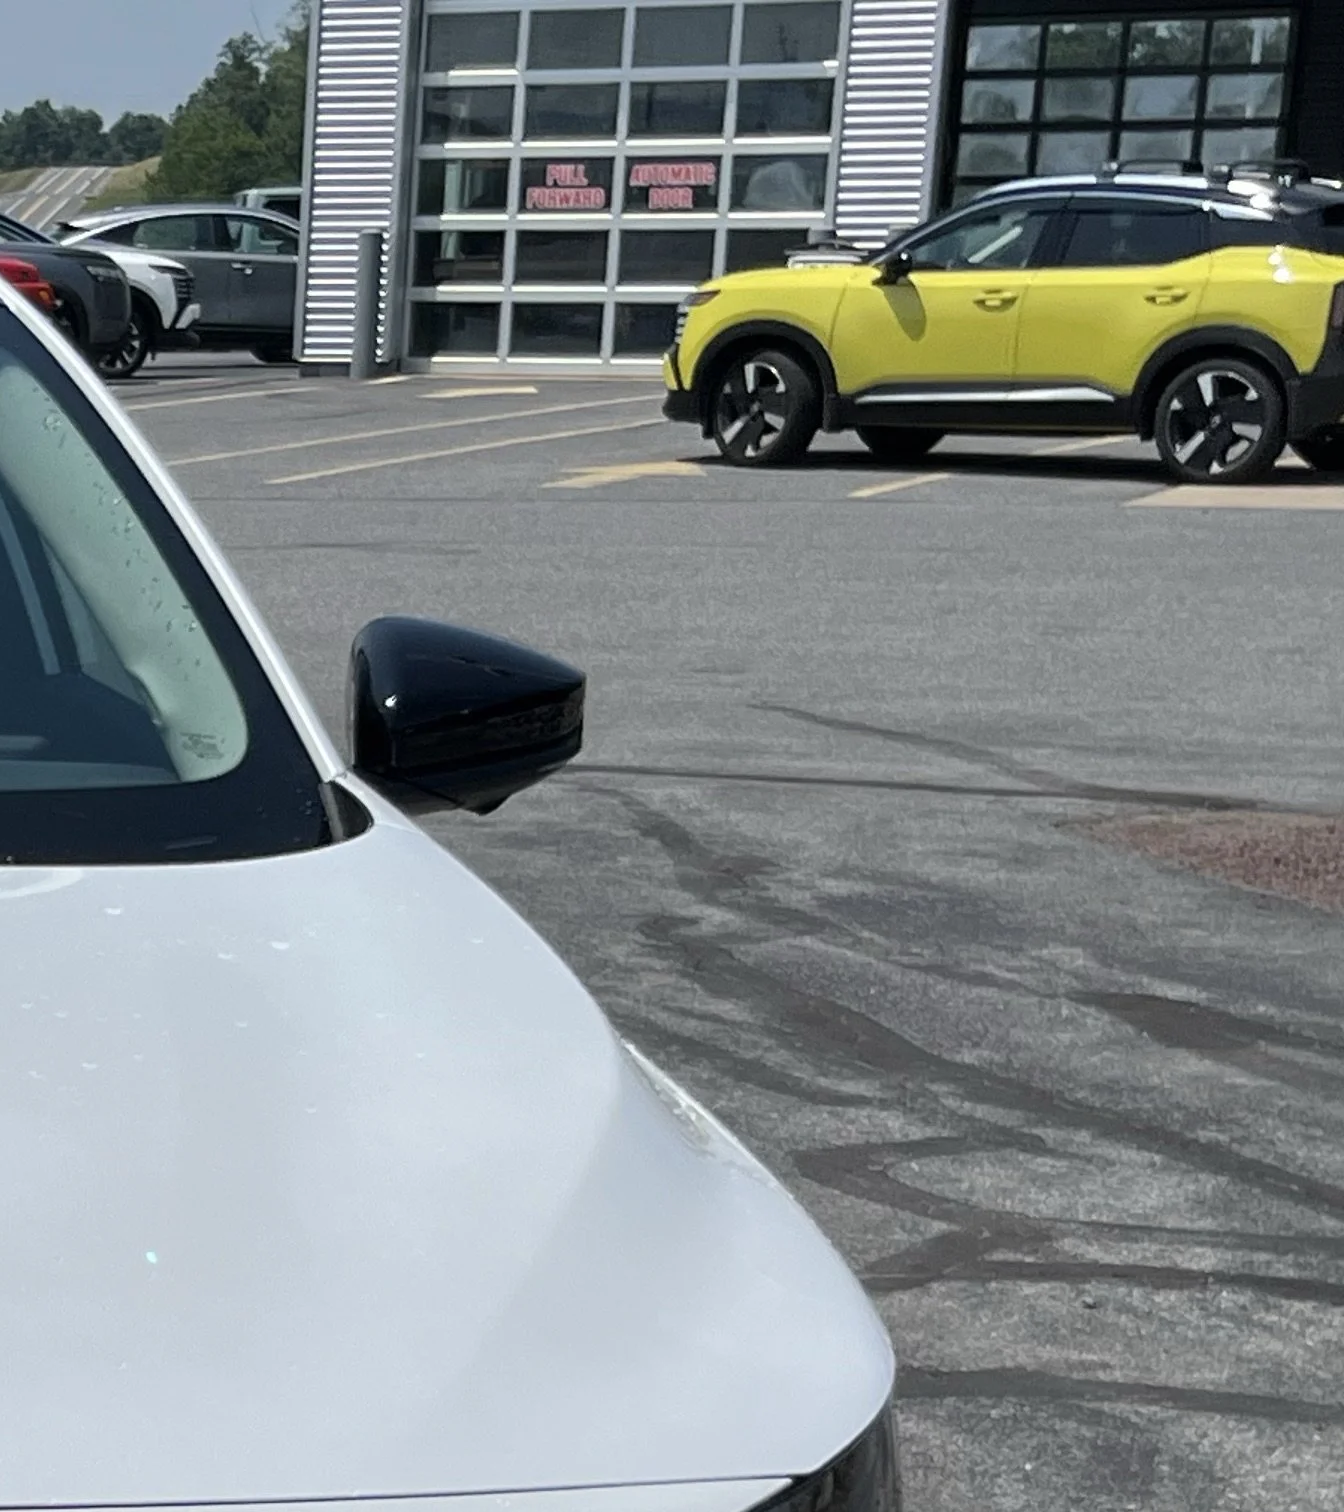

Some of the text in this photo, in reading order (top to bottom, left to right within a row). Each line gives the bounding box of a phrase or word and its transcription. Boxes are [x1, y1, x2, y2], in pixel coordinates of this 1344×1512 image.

[545, 164, 588, 186] PULL
[629, 163, 716, 187] AUTOMATIC
[526, 187, 605, 209] FORWARD
[648, 187, 693, 209] DOOR
